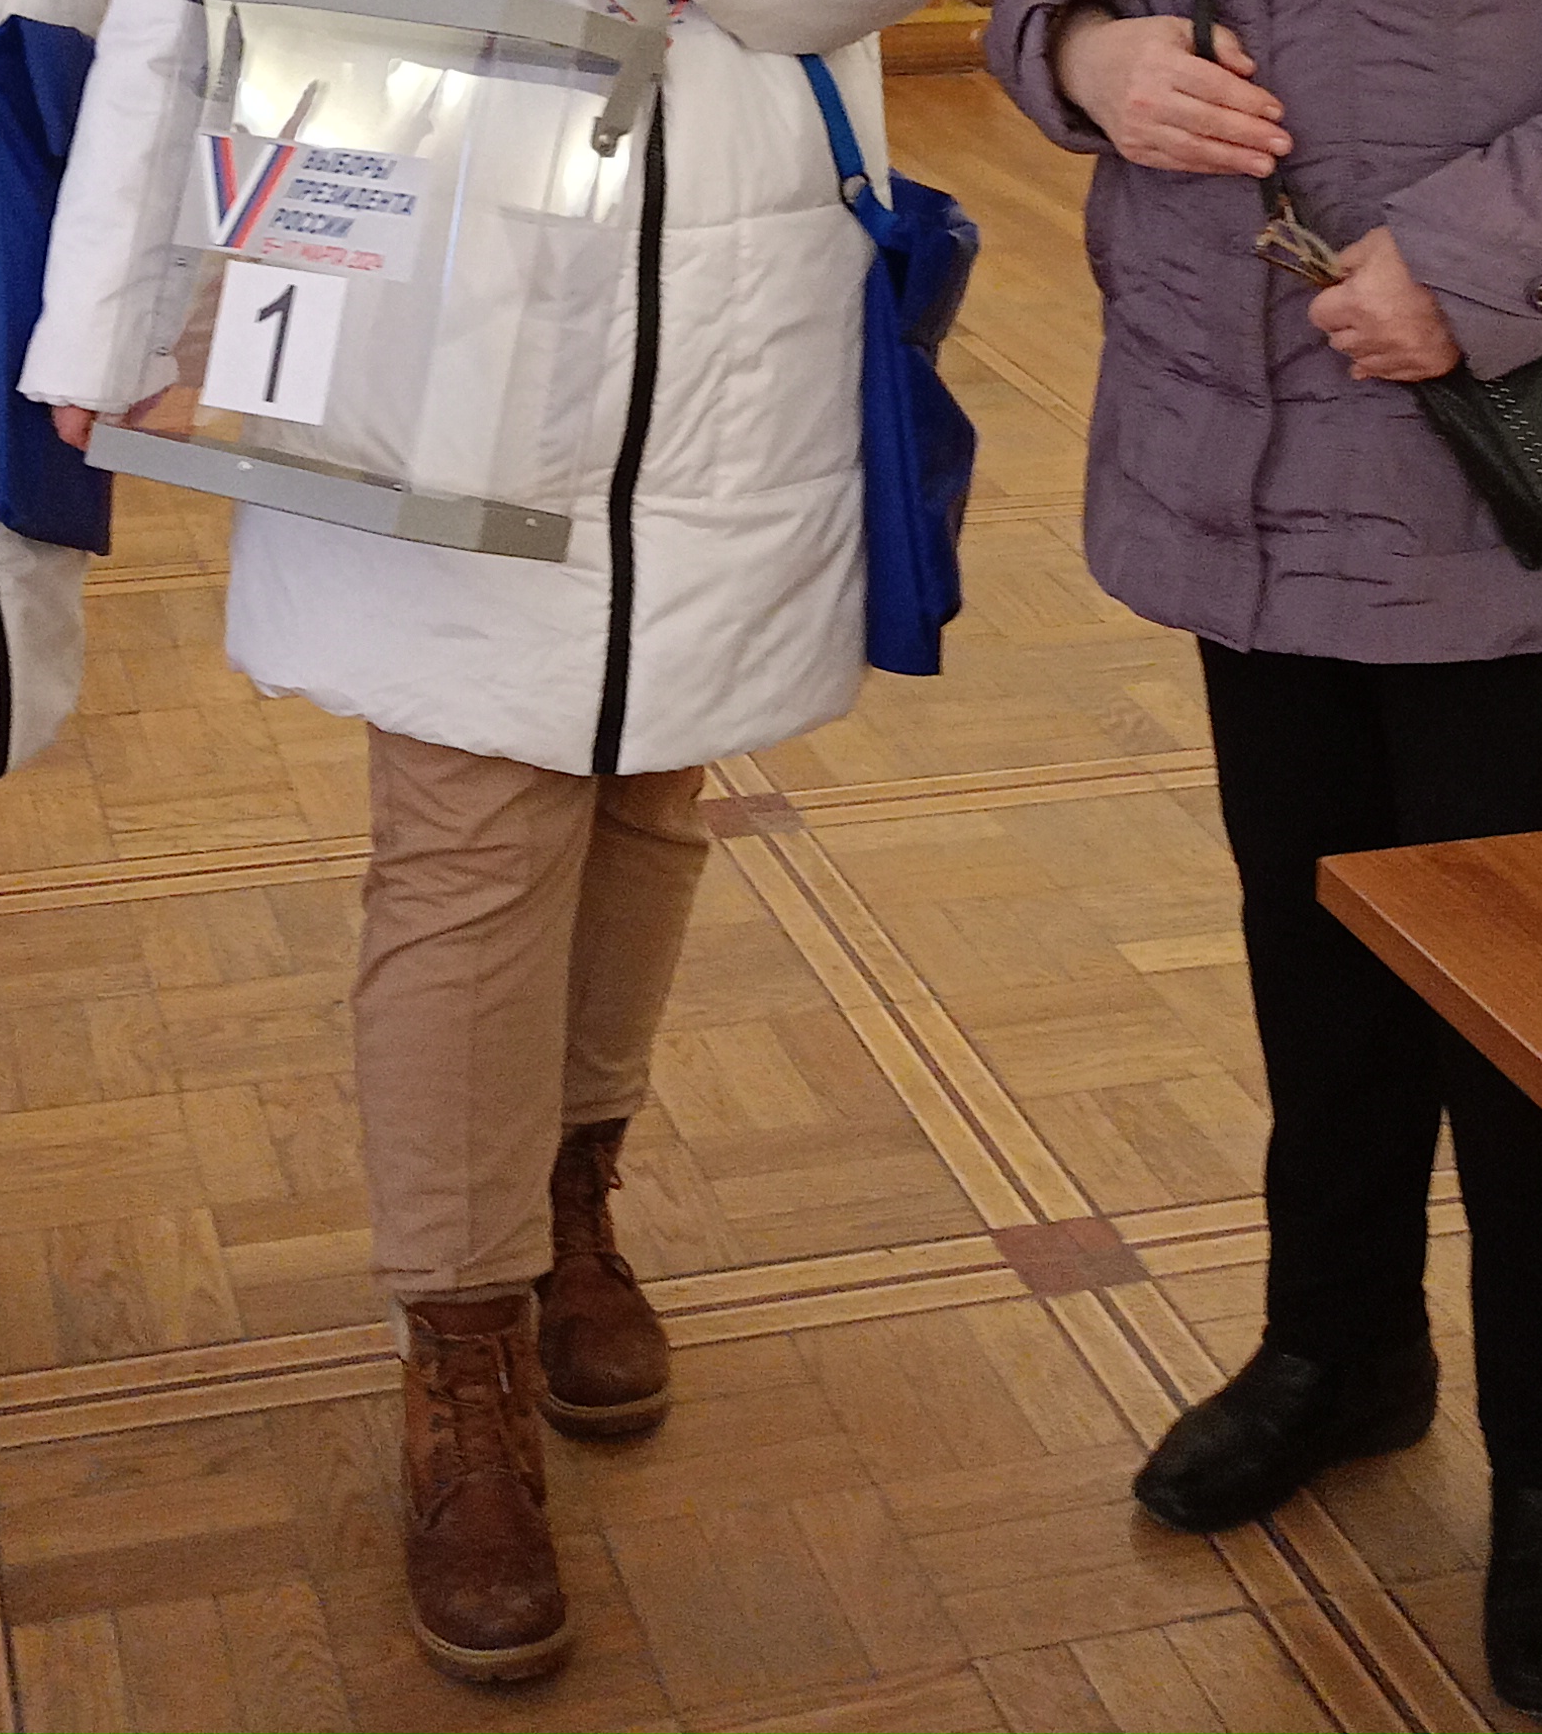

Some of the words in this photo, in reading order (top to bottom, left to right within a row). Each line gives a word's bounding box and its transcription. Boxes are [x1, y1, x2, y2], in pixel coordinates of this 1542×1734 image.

[303, 151, 397, 179] ВЫБОРЫ
[284, 178, 418, 215] ПРЕЗИДЕНТА
[268, 207, 356, 238] РОССИИ
[256, 284, 296, 402] 1
